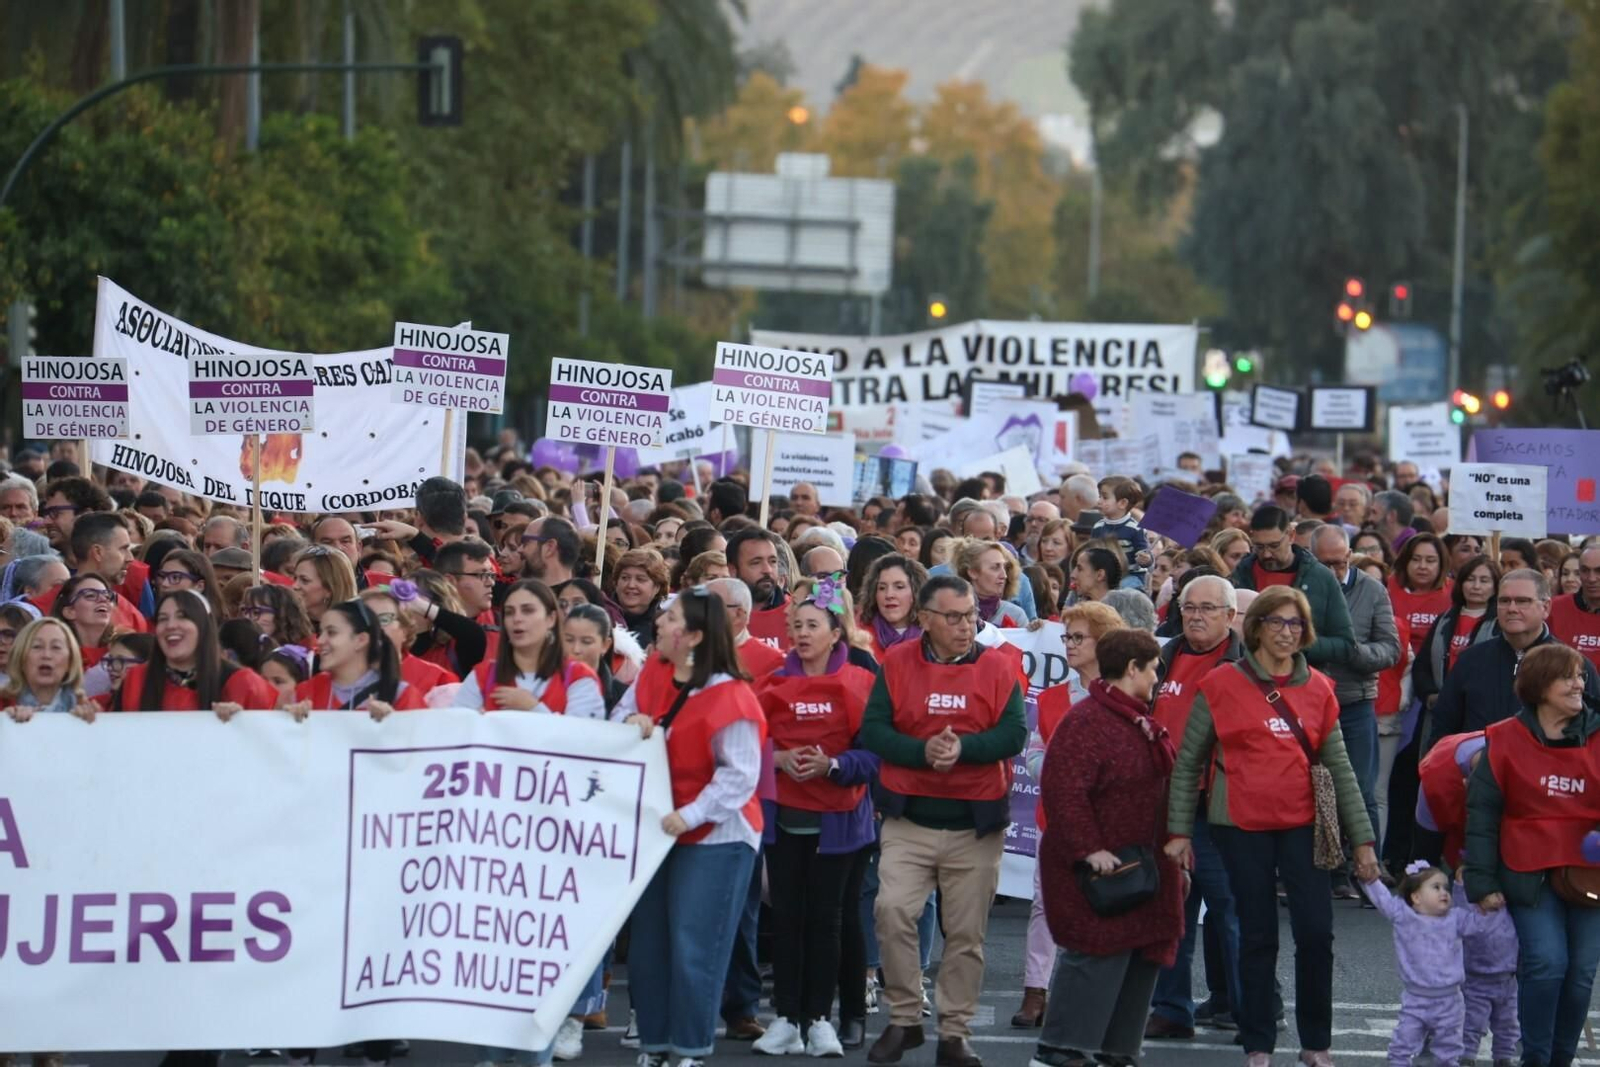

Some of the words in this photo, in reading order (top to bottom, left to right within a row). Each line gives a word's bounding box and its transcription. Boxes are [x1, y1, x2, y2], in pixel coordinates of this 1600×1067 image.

[400, 328, 502, 356] HINOJOSA
[862, 347, 886, 370] A
[903, 337, 949, 368] LA
[962, 335, 1163, 368] VIOLENCIA
[27, 360, 124, 381] HINOJOSA
[195, 359, 308, 378] HINOJOSA
[422, 354, 476, 371] CONTRA
[721, 348, 827, 377] HINOJOSA
[395, 369, 414, 384] LA
[418, 372, 500, 393] VIOLENCIA
[557, 363, 665, 392] HINOJOSA
[744, 374, 800, 392] CONTRA
[49, 385, 102, 399] CONTRA
[221, 383, 282, 395] CONTRA
[580, 390, 638, 408] CONTRA
[26, 403, 44, 416] LA
[48, 403, 126, 419] VIOLENCIA
[195, 402, 215, 414] LA
[220, 400, 310, 413] VIOLENCIA
[403, 390, 424, 404] DE
[428, 390, 490, 411] GÉNERO
[716, 388, 735, 404] LA
[740, 391, 824, 414] VIOLENCIA
[205, 420, 227, 433] DE
[232, 417, 300, 432] GÉNERO
[552, 405, 572, 420] LA
[577, 407, 663, 429] VIOLENCIA
[668, 408, 686, 422] Se
[723, 408, 744, 422] DE
[749, 408, 814, 431] GÉNERO
[36, 422, 54, 436] DE
[58, 421, 118, 438] GÉNERO
[560, 425, 581, 439] DE
[586, 426, 651, 447] GÉNERO
[1491, 436, 1575, 457] SACAMOS
[111, 444, 195, 489] HINOJOSA
[203, 476, 237, 501] DEL
[1510, 477, 1531, 486] una
[1485, 491, 1513, 502] frase
[1473, 510, 1524, 521] completa
[422, 761, 502, 800] 25N
[514, 760, 570, 807] DÍA
[1540, 775, 1585, 793] #25N
[361, 808, 627, 860] INTERNACIONAL
[400, 855, 528, 899] CONTRA
[538, 864, 580, 904] LA
[401, 901, 569, 951] VIOLENCIA
[356, 955, 373, 992] A
[382, 949, 441, 987] LAS
[454, 951, 570, 997] MUJER
